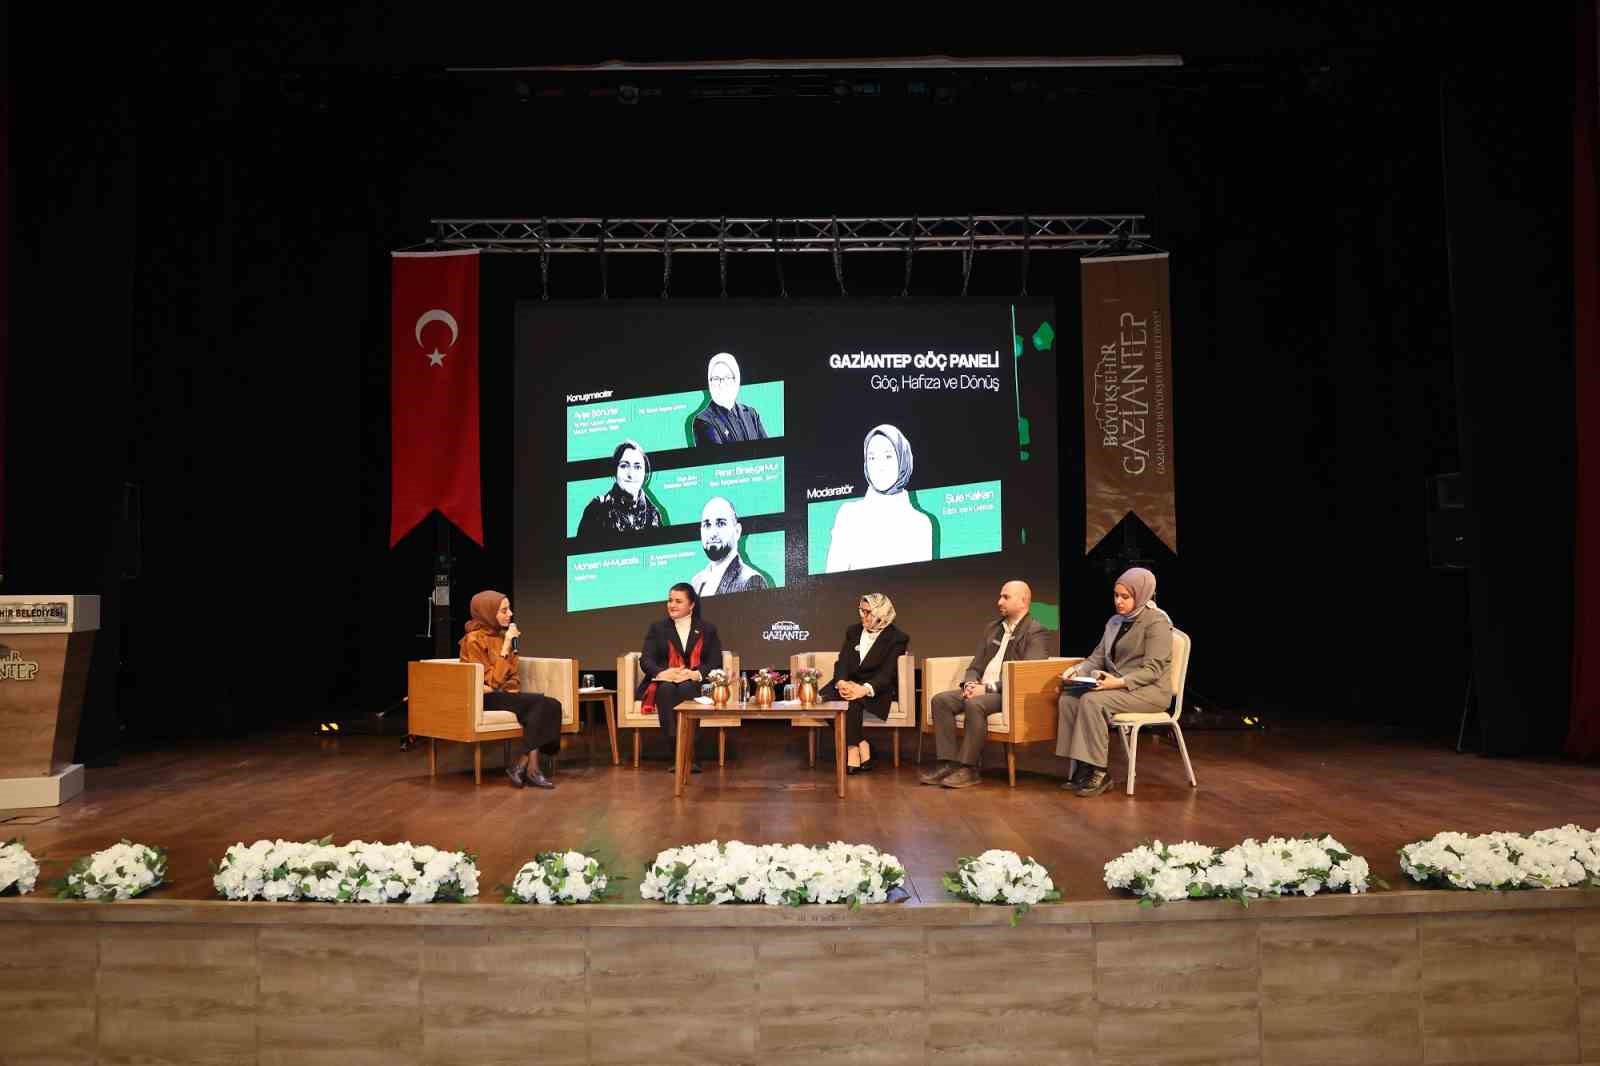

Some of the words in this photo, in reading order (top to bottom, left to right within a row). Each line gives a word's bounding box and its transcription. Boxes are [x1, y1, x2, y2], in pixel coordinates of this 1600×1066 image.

[829, 350, 912, 369] GAZİANTEP
[913, 350, 948, 372] GÖÇ
[949, 350, 1000, 369] PANELİ
[870, 374, 899, 392] Göç,
[901, 374, 940, 389] Hafıza
[943, 377, 958, 389] ve
[960, 374, 1000, 392] Dönüş
[1118, 312, 1150, 475] GAZİANTEP
[807, 484, 855, 500] Moderatör
[16, 607, 63, 618] BELEDİYESİ
